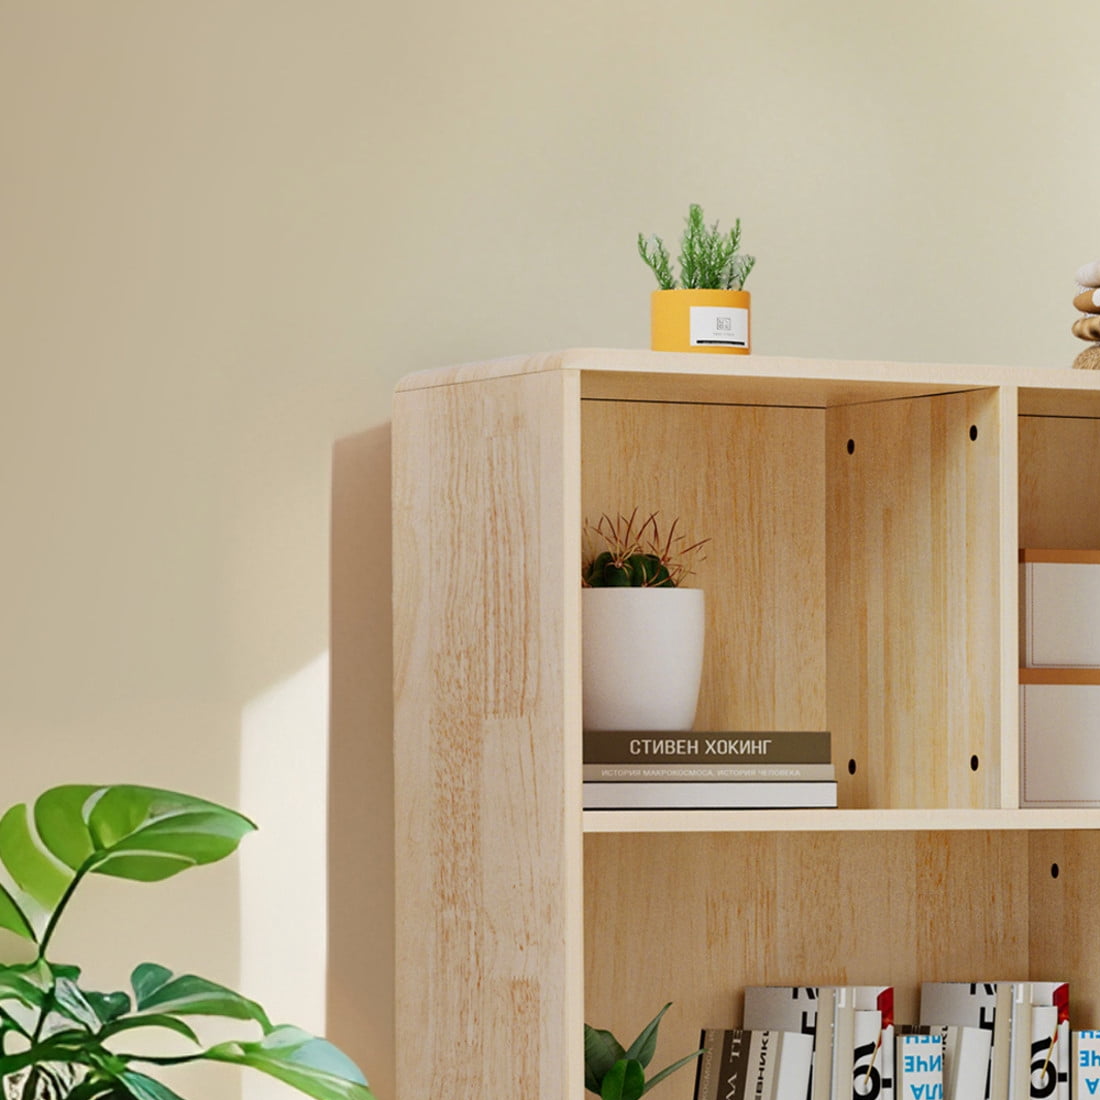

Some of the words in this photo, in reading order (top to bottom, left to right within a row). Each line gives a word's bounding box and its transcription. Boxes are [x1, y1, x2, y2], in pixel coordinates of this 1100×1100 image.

[629, 739, 700, 756] СТИВЕН
[704, 739, 773, 755] ХОКИНГ
[601, 768, 642, 778] ИСТОРИЯ
[643, 768, 714, 779] МАКРОКОСМОСА,
[716, 768, 757, 778] ИСТОРИЯ
